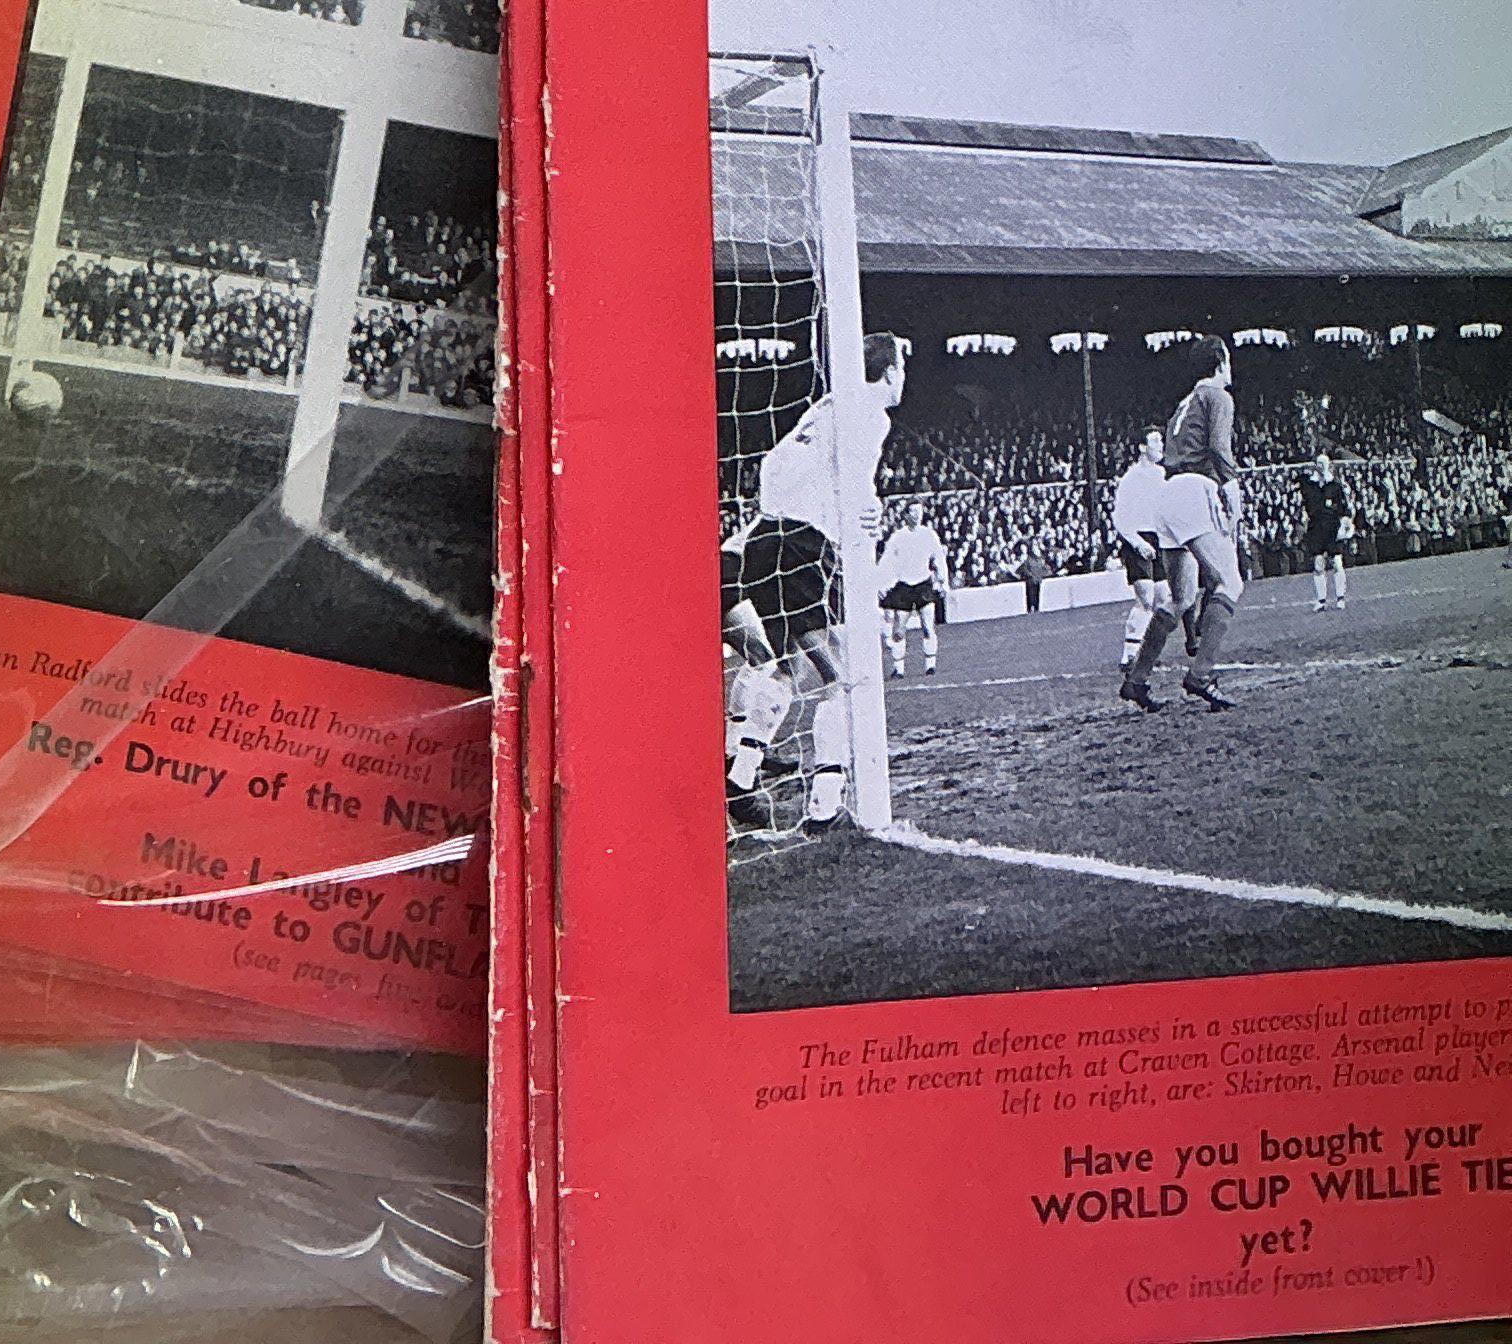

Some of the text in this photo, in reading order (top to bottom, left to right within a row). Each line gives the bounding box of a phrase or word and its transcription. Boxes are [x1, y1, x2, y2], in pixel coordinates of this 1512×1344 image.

[218, 690, 260, 718] the
[269, 699, 320, 730] ball
[327, 711, 399, 746] home
[26, 720, 362, 820] Reg. Drury of the
[208, 717, 433, 785] Highbury against
[141, 831, 447, 926] Mike of
[273, 910, 311, 943] to
[799, 1000, 1452, 1070] The Fulham defence masses in successful attempt
[754, 1026, 1426, 1111] goal in the recent match Craven Arsenal
[999, 1057, 1461, 1119] left to right, are: Skirton, Howe and
[1064, 1121, 1483, 1179] Have you bought your
[1030, 1162, 1442, 1226] WORLD CUP WILLIE
[1239, 1218, 1314, 1269] yet?
[1124, 1264, 1335, 1306] (See inside front
